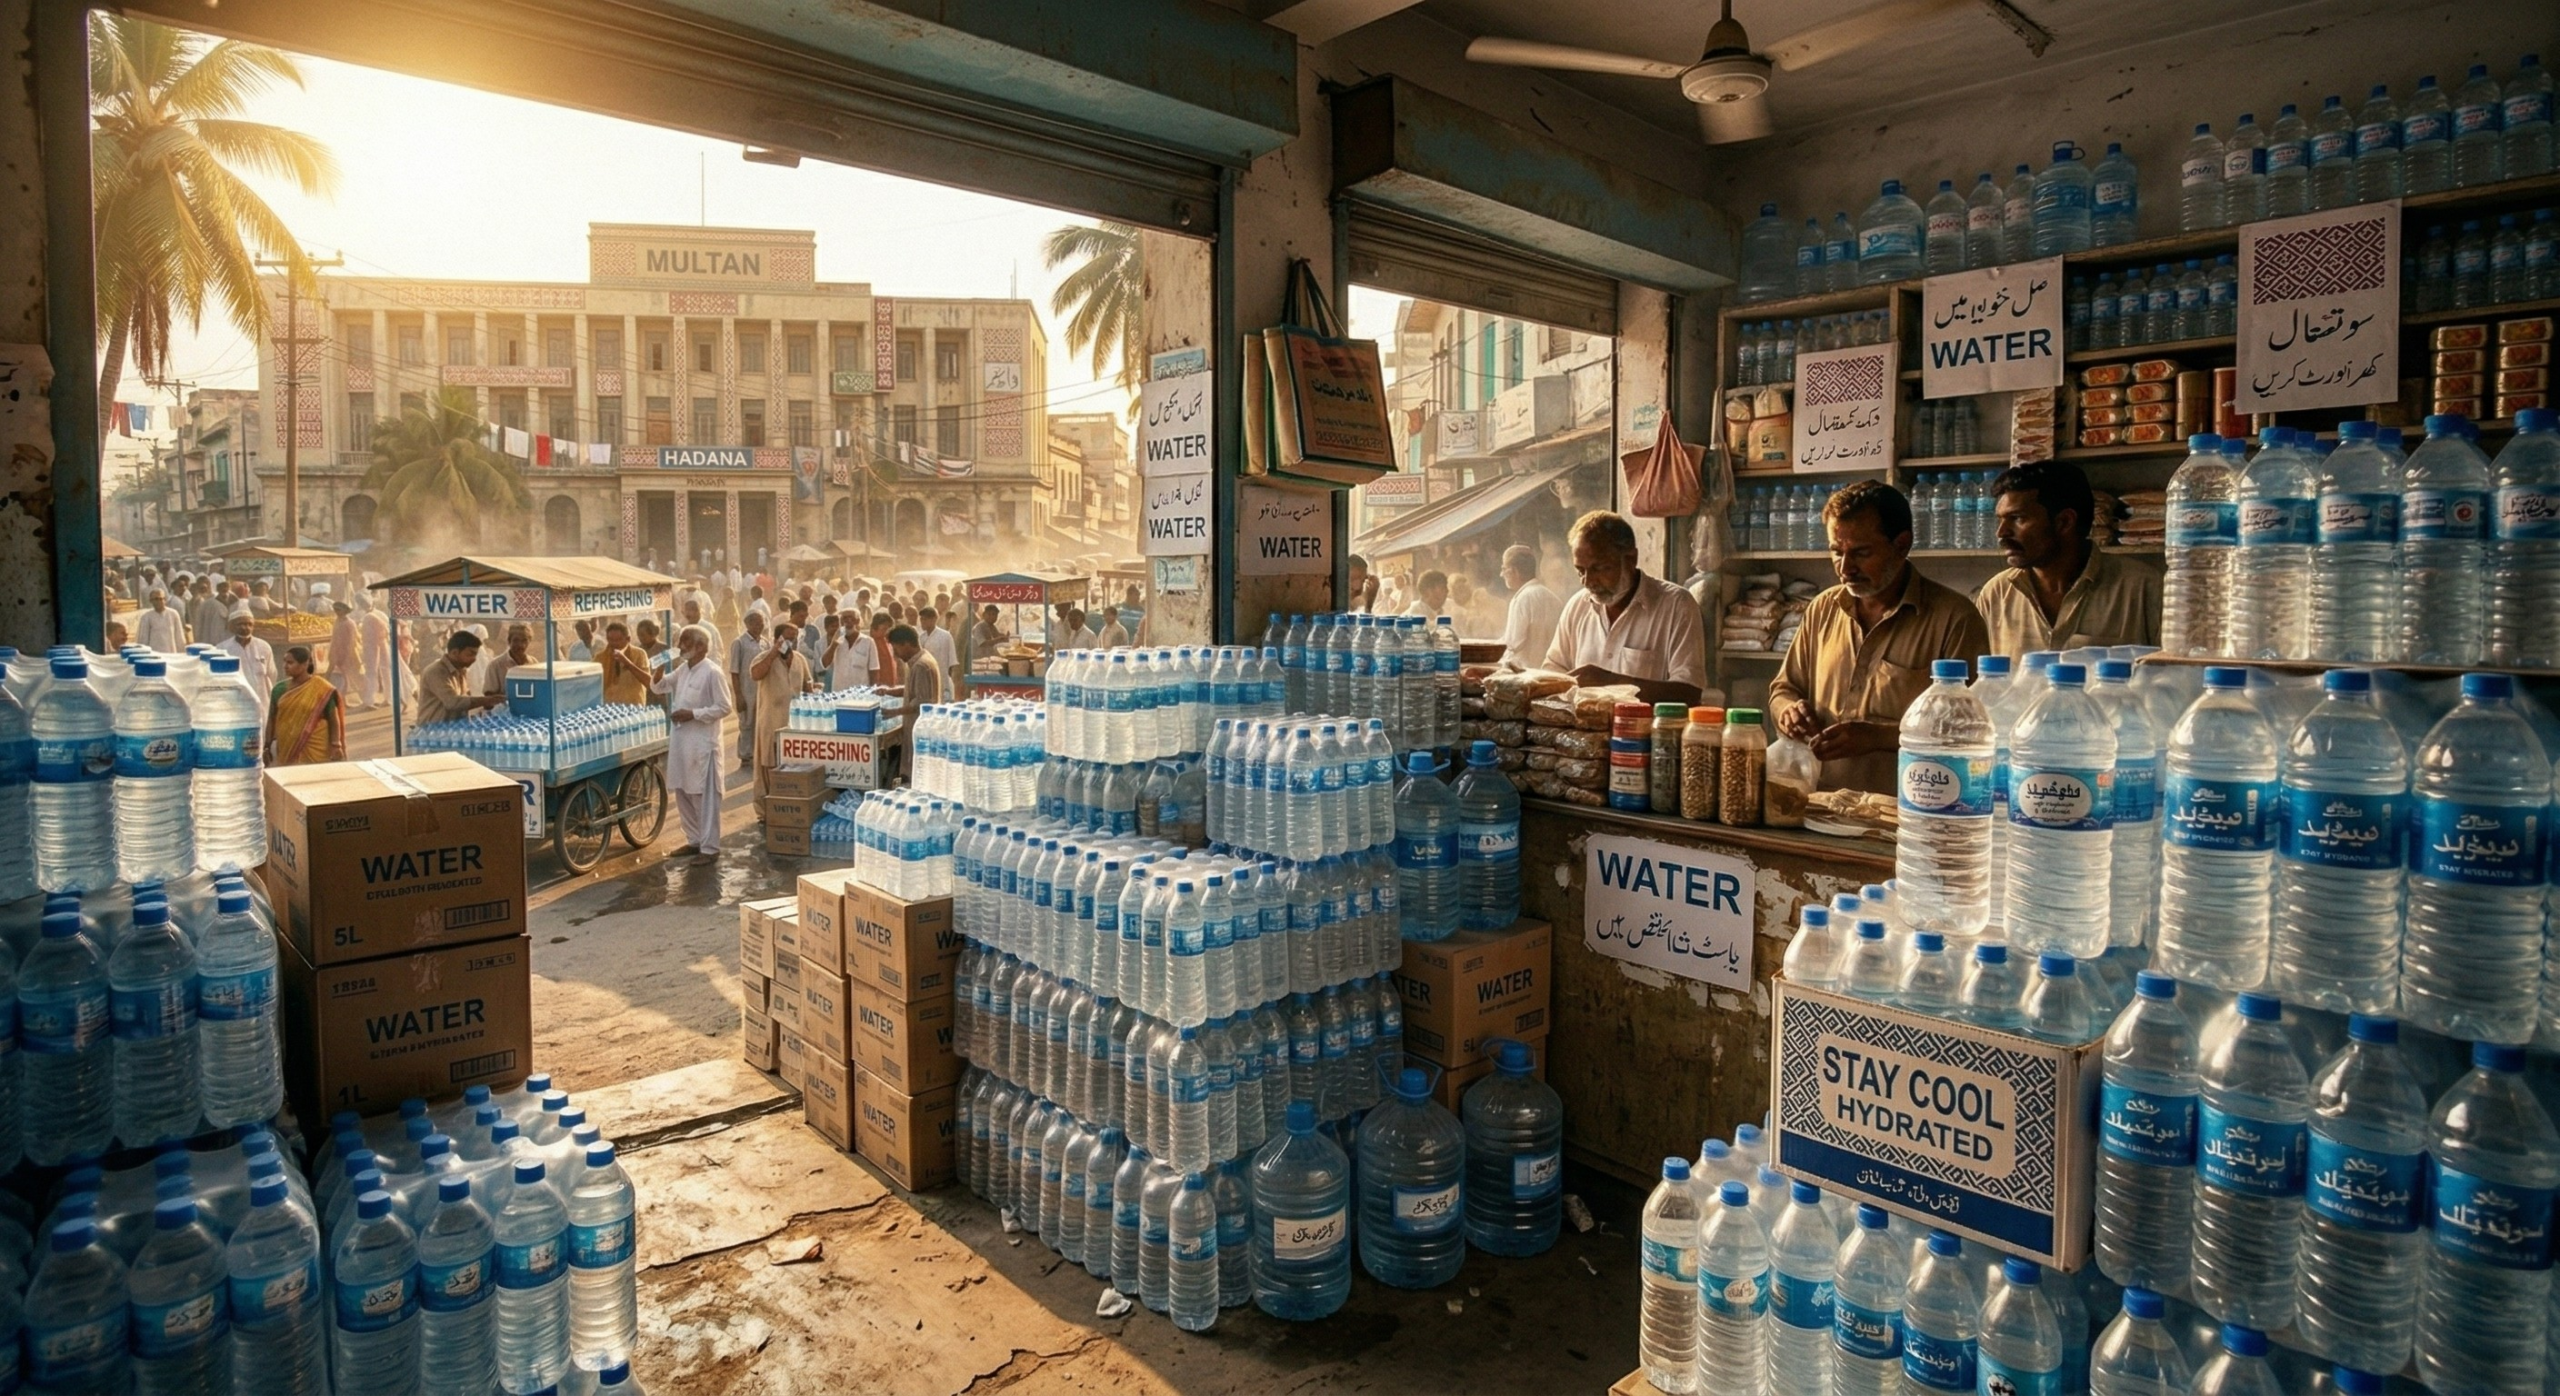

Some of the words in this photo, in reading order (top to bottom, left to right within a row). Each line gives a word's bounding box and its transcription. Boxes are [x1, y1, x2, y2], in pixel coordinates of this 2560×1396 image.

[646, 248, 761, 277] MULTAN
[1930, 328, 2053, 369] WATER
[664, 450, 748, 467] HADANA
[1147, 433, 1207, 462] WATER
[1149, 516, 1206, 539] WATER
[1259, 536, 1323, 559] WATER
[424, 592, 509, 615] WATER
[574, 588, 654, 613] REFRESHING
[783, 738, 871, 763] REFRESHING
[361, 844, 484, 884] WATER
[1596, 848, 1743, 917] WATER
[334, 925, 364, 947] 5L
[855, 915, 893, 948] WATER
[1398, 974, 1432, 1005] TER
[1476, 967, 1534, 1004] WATER
[366, 998, 485, 1045] WATER
[859, 1005, 895, 1039] WATER
[337, 1083, 370, 1106] 1L
[1822, 1044, 1902, 1101] STAY
[1908, 1068, 2006, 1132] COOL
[862, 1100, 897, 1138] WATER
[1837, 1093, 1994, 1163] HYDRATED
